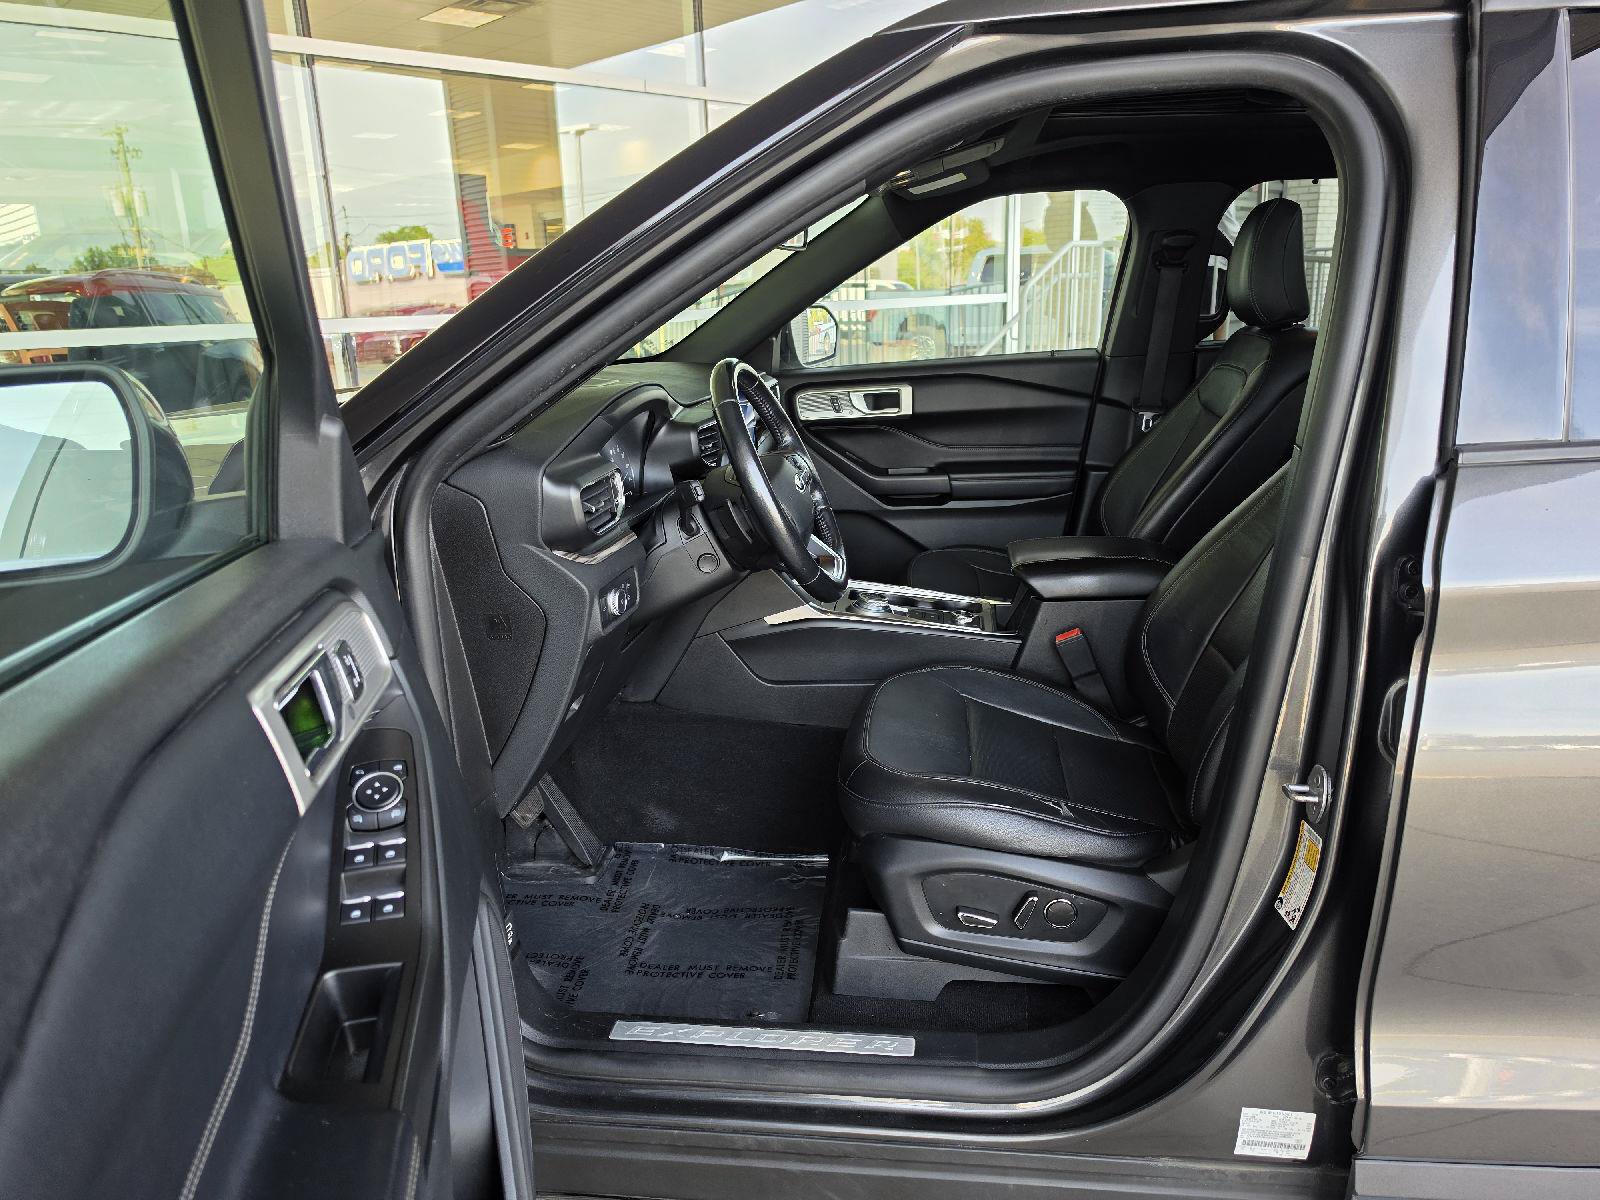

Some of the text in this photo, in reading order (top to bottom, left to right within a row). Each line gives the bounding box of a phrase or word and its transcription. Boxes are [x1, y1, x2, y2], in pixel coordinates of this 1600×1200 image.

[558, 894, 603, 904] REMOVE
[639, 963, 680, 971] DEALER
[726, 964, 773, 973] REMOVE
[636, 969, 704, 979] PROTECTIVE
[624, 1025, 899, 1051] EXPLORER
